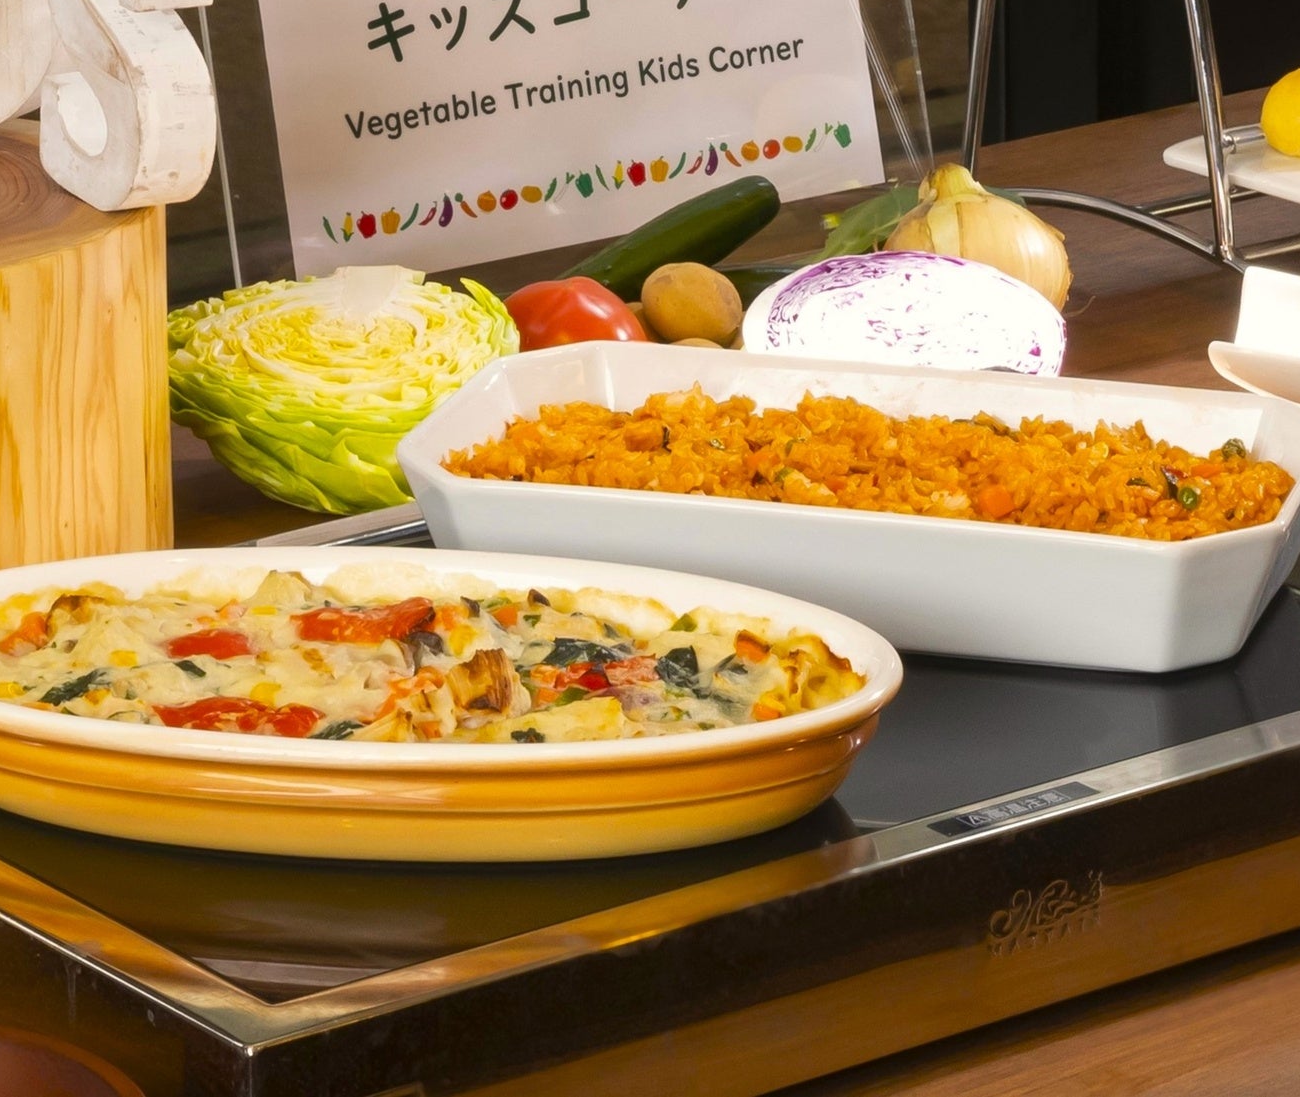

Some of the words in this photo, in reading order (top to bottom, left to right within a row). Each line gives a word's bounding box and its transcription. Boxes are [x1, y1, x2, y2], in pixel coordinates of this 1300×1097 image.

[345, 90, 497, 141] Vegetable
[504, 65, 630, 110] Training
[638, 50, 700, 86] Kids
[708, 35, 804, 74] Corner
